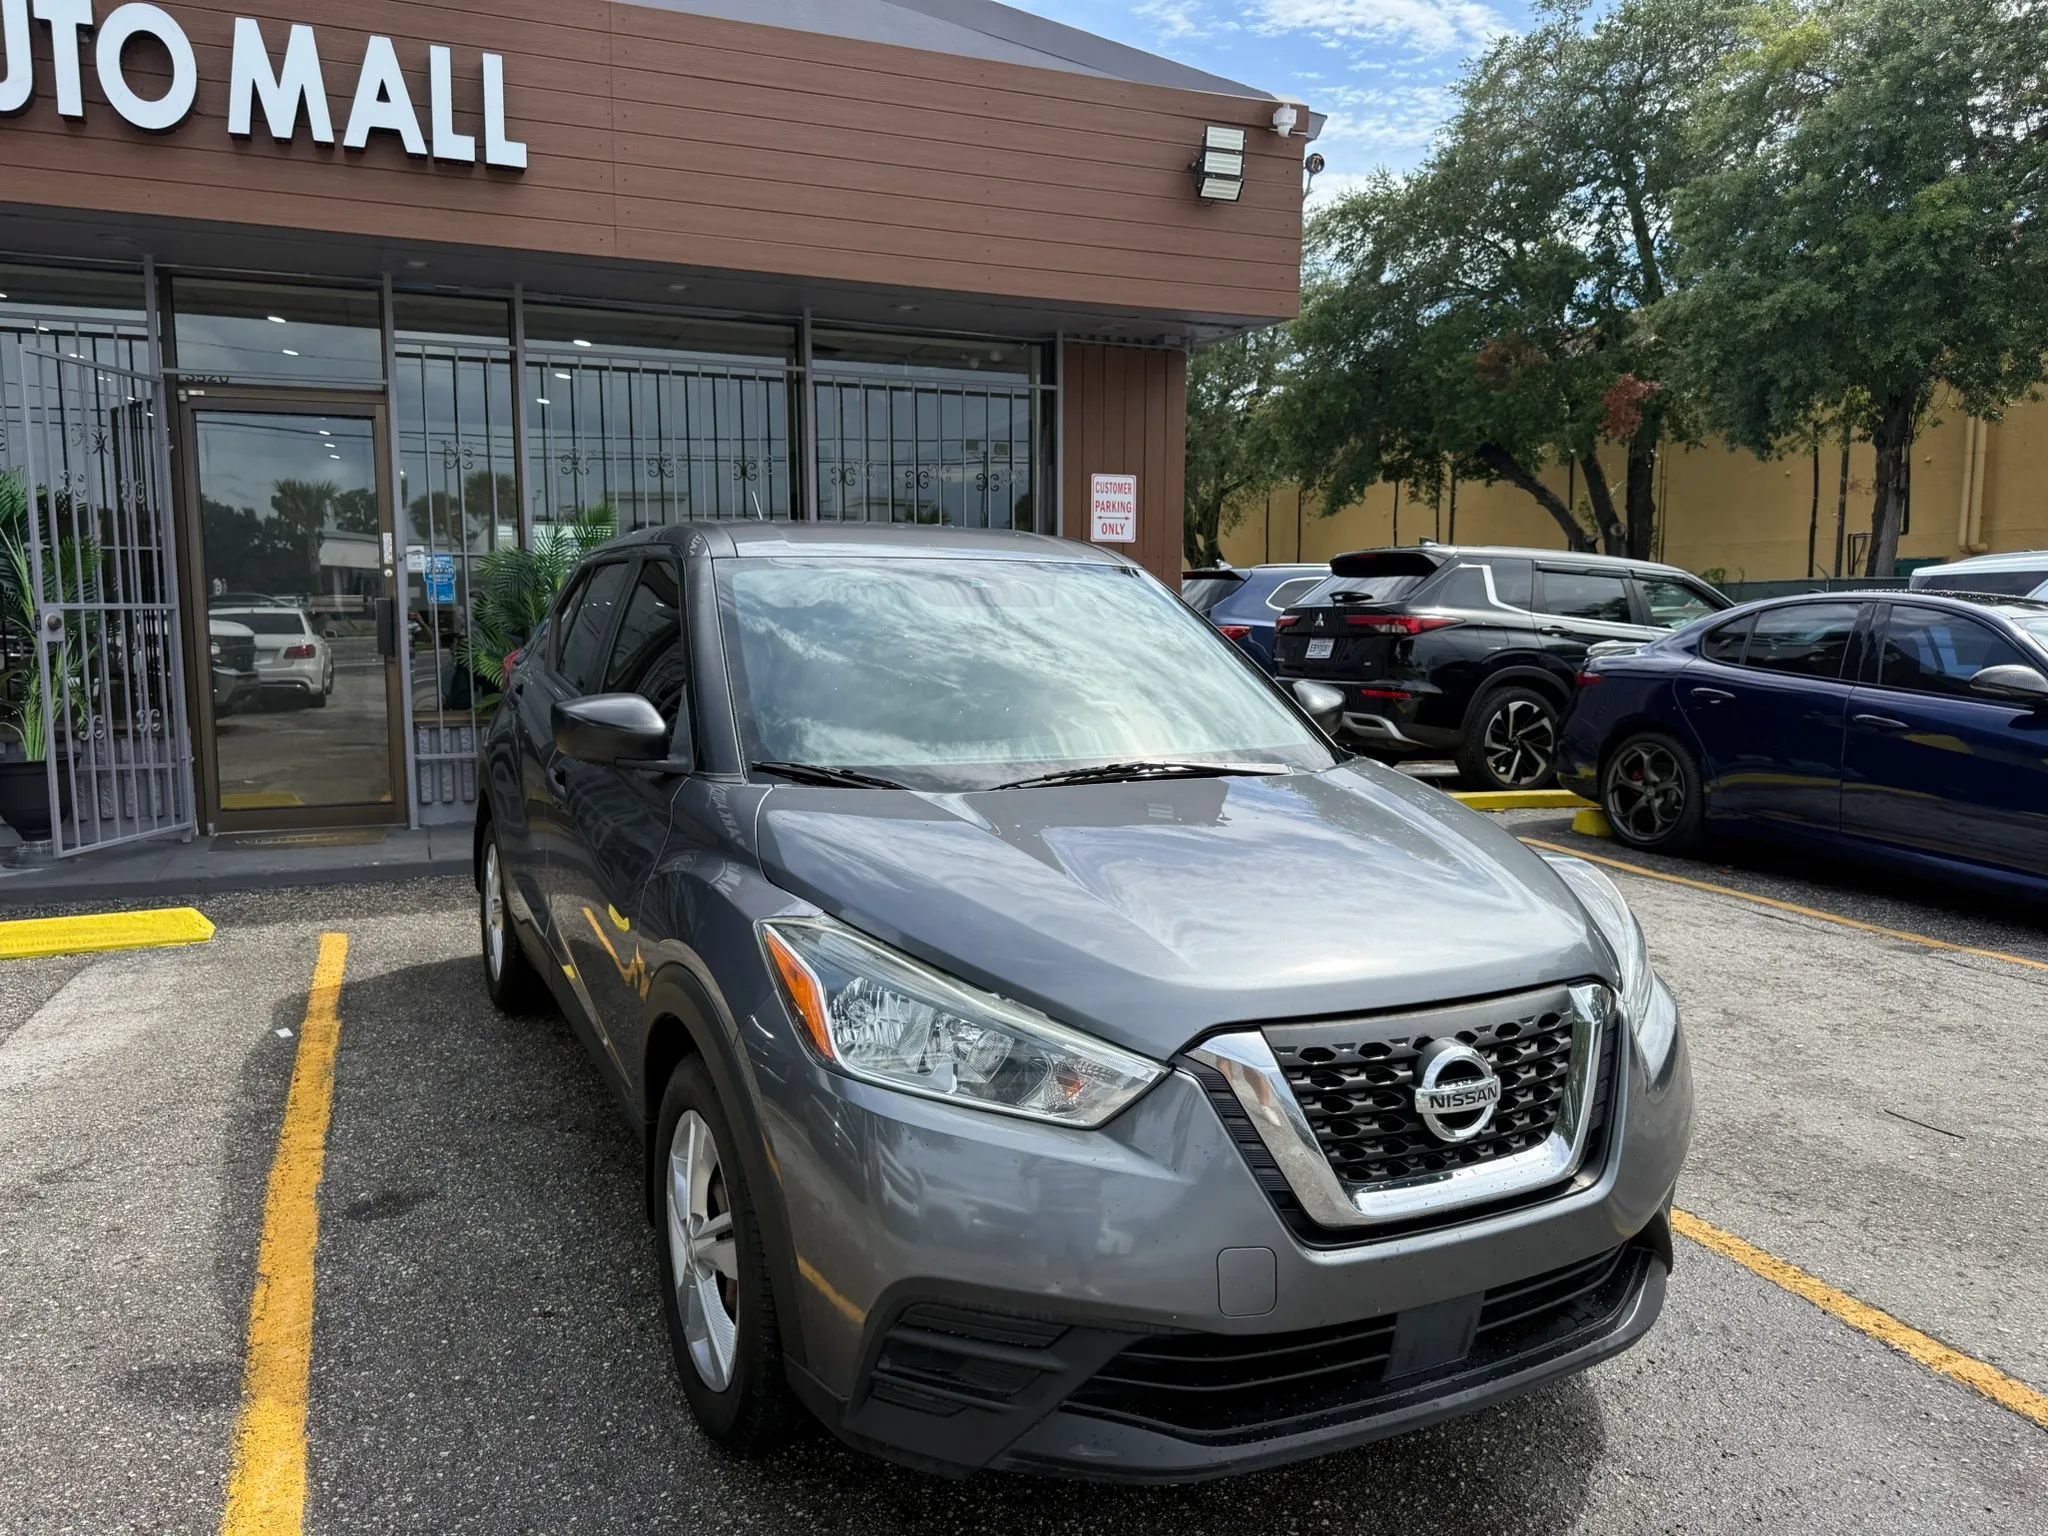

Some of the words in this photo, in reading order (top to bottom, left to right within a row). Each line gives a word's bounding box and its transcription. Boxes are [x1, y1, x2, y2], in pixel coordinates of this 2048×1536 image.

[228, 17, 527, 168] MALL
[1095, 481, 1132, 495] CUSTOMER
[1095, 500, 1132, 513] PARKING
[1101, 522, 1126, 535] ONLY
[1428, 1085, 1497, 1109] NISSAN
